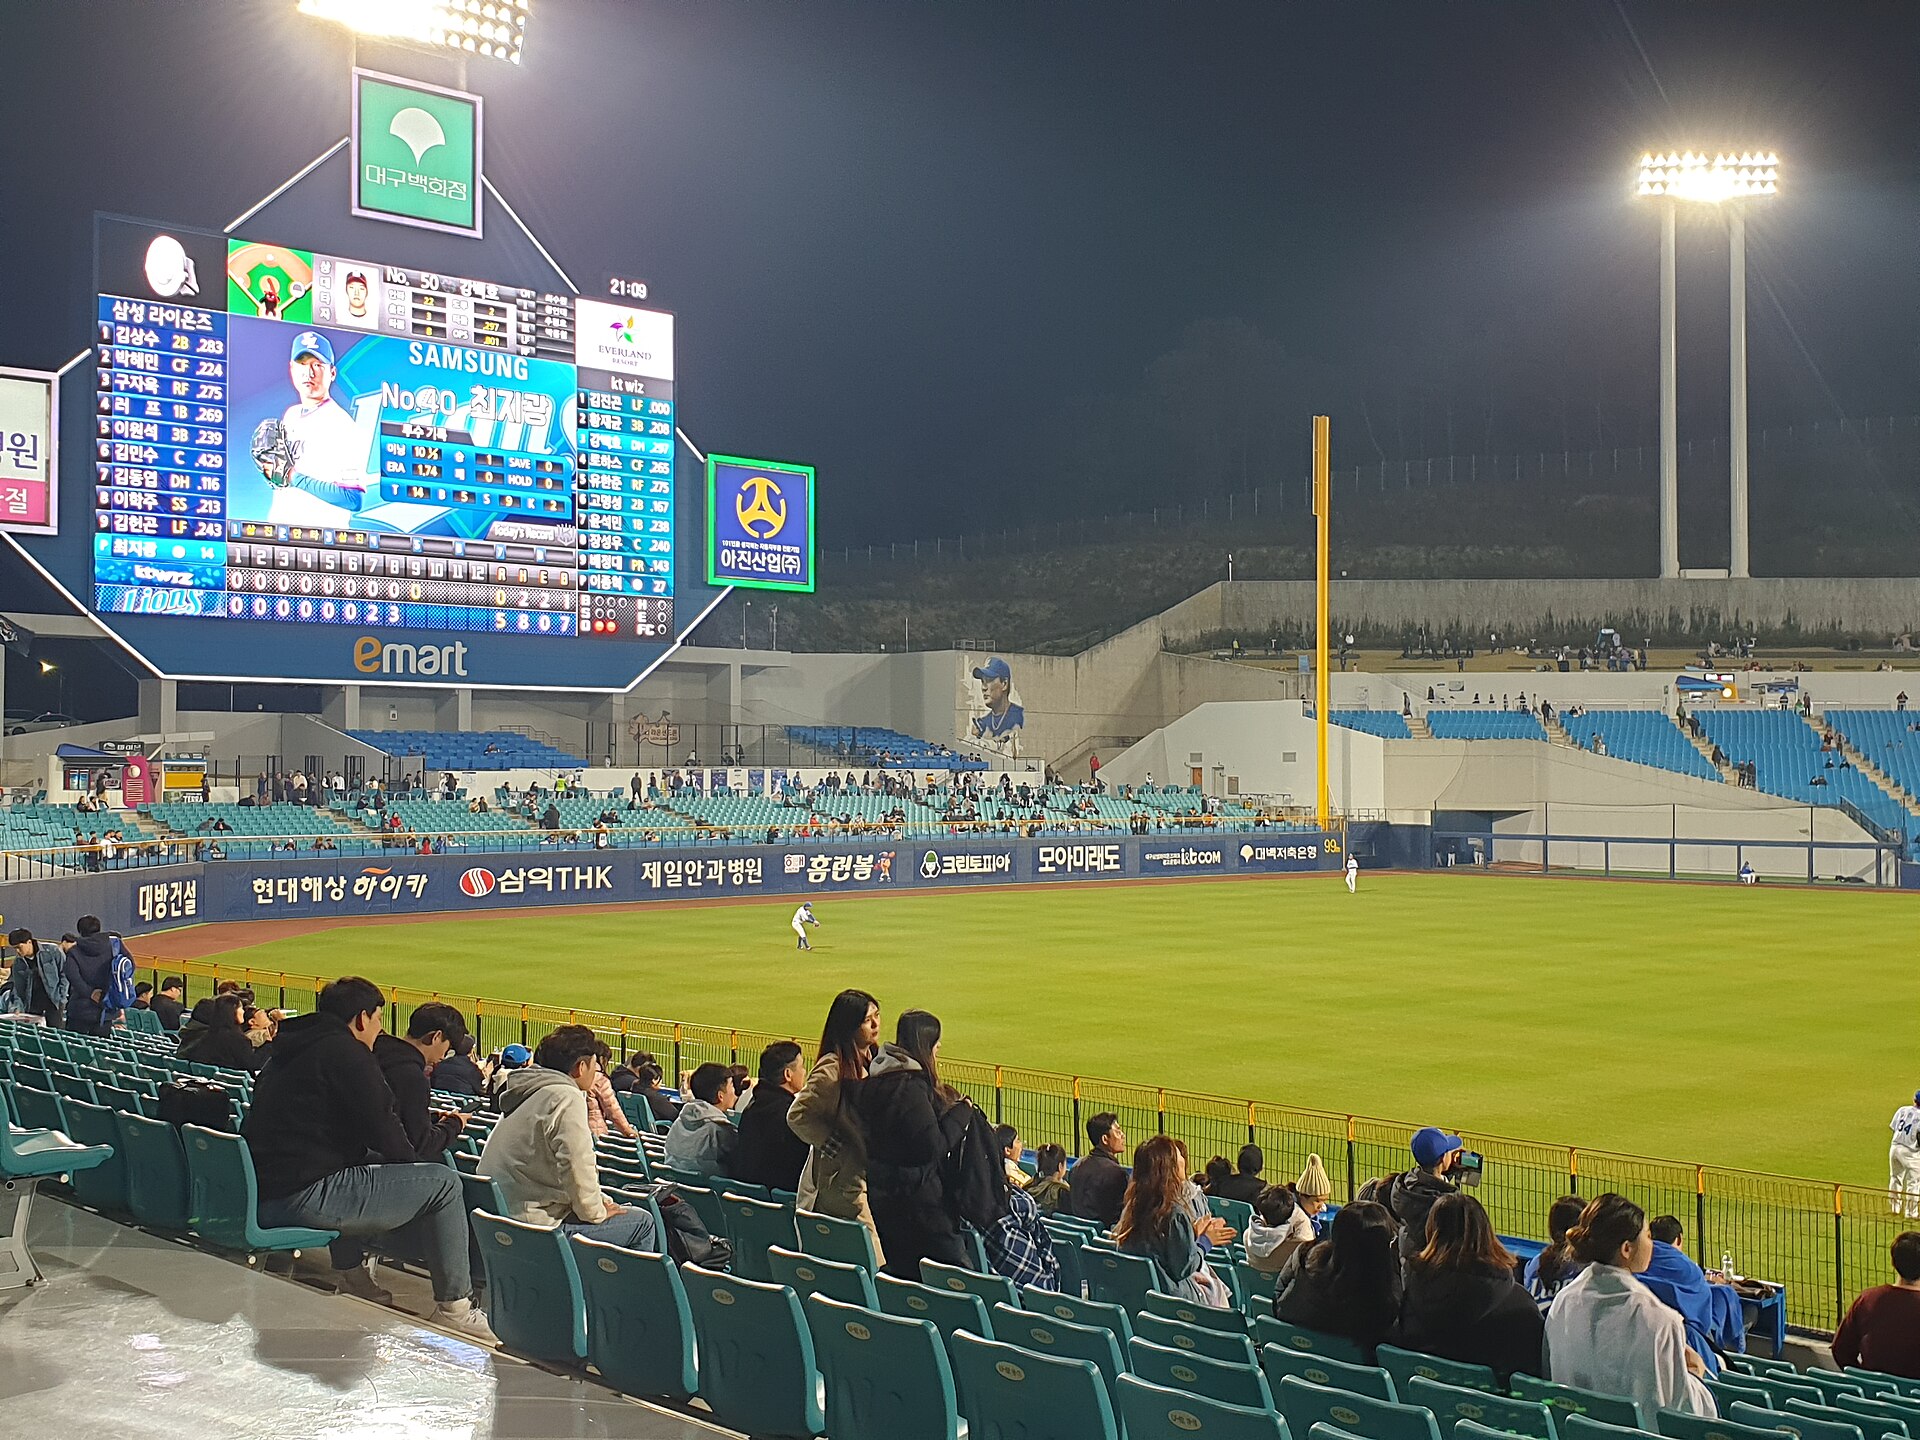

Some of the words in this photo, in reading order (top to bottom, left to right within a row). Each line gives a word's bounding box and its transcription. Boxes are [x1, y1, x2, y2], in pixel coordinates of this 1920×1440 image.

[366, 164, 466, 201] 대구백화점
[386, 266, 410, 286] No.
[420, 274, 440, 291] 50
[610, 278, 647, 299] 21:09
[113, 301, 145, 323] 삼성
[149, 306, 213, 331] 라이온즈
[102, 326, 110, 339] 1
[116, 326, 160, 347] 김상수
[172, 335, 190, 350] 2B
[196, 339, 224, 354] .283
[101, 350, 110, 363] 2
[172, 358, 190, 373] CF
[196, 362, 223, 377] .224
[408, 341, 529, 381] SAMSUNG
[599, 345, 652, 361] EVERLAND
[101, 373, 110, 386] 3
[115, 373, 159, 394] 구자욱
[173, 381, 190, 396] RF
[196, 385, 223, 399] .275
[611, 376, 623, 391] kt
[625, 380, 645, 394] wiz
[100, 397, 110, 410] 4
[115, 397, 130, 414] 러
[145, 401, 162, 416] 프
[173, 405, 188, 419] 1B
[195, 408, 223, 422] .269
[469, 384, 550, 426] 최지광
[590, 392, 622, 411] 김진곤
[632, 399, 644, 411] LF
[649, 402, 670, 415] .000
[100, 420, 110, 433] 5
[114, 421, 158, 441] 이원석
[171, 427, 189, 442] 3B
[195, 430, 223, 445] .239
[631, 419, 644, 432] 3B
[100, 443, 110, 457] 6
[114, 444, 159, 464] 김민수
[174, 450, 185, 465] C
[194, 453, 223, 468] .429
[508, 458, 531, 470] SAVE
[544, 461, 554, 472] 0
[590, 453, 622, 469] 로하스
[632, 459, 644, 471] CF
[100, 467, 110, 480] 7
[114, 468, 158, 488] 김동엽
[170, 474, 190, 489] DH
[197, 476, 220, 491] .116
[386, 462, 406, 474] ERA
[417, 465, 438, 477] 1.74
[484, 470, 494, 482] 0
[508, 475, 533, 487] HOLD
[544, 478, 553, 490] 0
[632, 479, 644, 491] RF
[0, 488, 28, 515] 절
[100, 491, 109, 504] 8
[113, 491, 159, 510] 이학주
[171, 496, 188, 511] SS
[196, 500, 221, 514] .213
[461, 491, 469, 503] 5
[483, 493, 491, 505] S
[549, 500, 557, 512] 2
[631, 500, 644, 511] 2B
[100, 514, 109, 528] 9
[171, 520, 188, 534] LF
[194, 522, 222, 537] .243
[632, 518, 643, 530] 1B
[633, 538, 642, 550] C
[649, 540, 670, 552] .240
[235, 548, 242, 563] 1
[256, 550, 267, 566] 2
[279, 551, 289, 566] 3
[302, 553, 311, 568] 4
[325, 555, 335, 569] 5
[349, 556, 358, 571] 6
[369, 558, 378, 573] 7
[390, 560, 399, 574] 8
[411, 562, 421, 576] 9
[430, 562, 443, 577] 10
[452, 564, 463, 579] 11
[472, 565, 485, 580] 12
[631, 559, 644, 572] PR
[721, 549, 801, 575] 아진산업(주)
[232, 571, 243, 589] 0
[254, 573, 267, 590] 0
[278, 574, 289, 592] 0
[301, 576, 312, 593] 0
[323, 578, 335, 595] 0
[345, 579, 356, 596] 0
[367, 581, 378, 597] 0
[389, 582, 400, 598] 0
[411, 585, 421, 601] 0
[496, 590, 506, 605] 0
[519, 591, 529, 606] 2
[539, 593, 550, 608] 2
[563, 594, 571, 609] 1
[653, 580, 667, 593] 27
[123, 587, 205, 616] Lions
[580, 594, 591, 607] B
[636, 598, 647, 611] H
[231, 597, 243, 614] 0
[254, 598, 267, 615] 0
[278, 600, 289, 616] 0
[301, 601, 312, 618] 0
[323, 603, 335, 619] 0
[345, 604, 357, 620] 0
[367, 605, 378, 621] 2
[389, 606, 399, 623] 3
[496, 612, 506, 629] 5
[518, 614, 529, 630] 8
[539, 615, 550, 631] 0
[560, 616, 570, 632] 7
[580, 607, 591, 619] S
[637, 611, 647, 623] E
[636, 623, 655, 636] FC
[353, 636, 468, 676] emart
[942, 852, 1011, 875] 크린토피아
[1038, 845, 1121, 873] 모아미래도
[1255, 845, 1317, 860] 대백저축은행
[497, 865, 613, 894] 삼익THK
[641, 857, 763, 889] 제일안과병원
[806, 854, 874, 883] 홈런볼
[138, 879, 197, 921] 대방건설
[252, 875, 348, 905] 현대해상
[353, 873, 429, 901] 하이카
